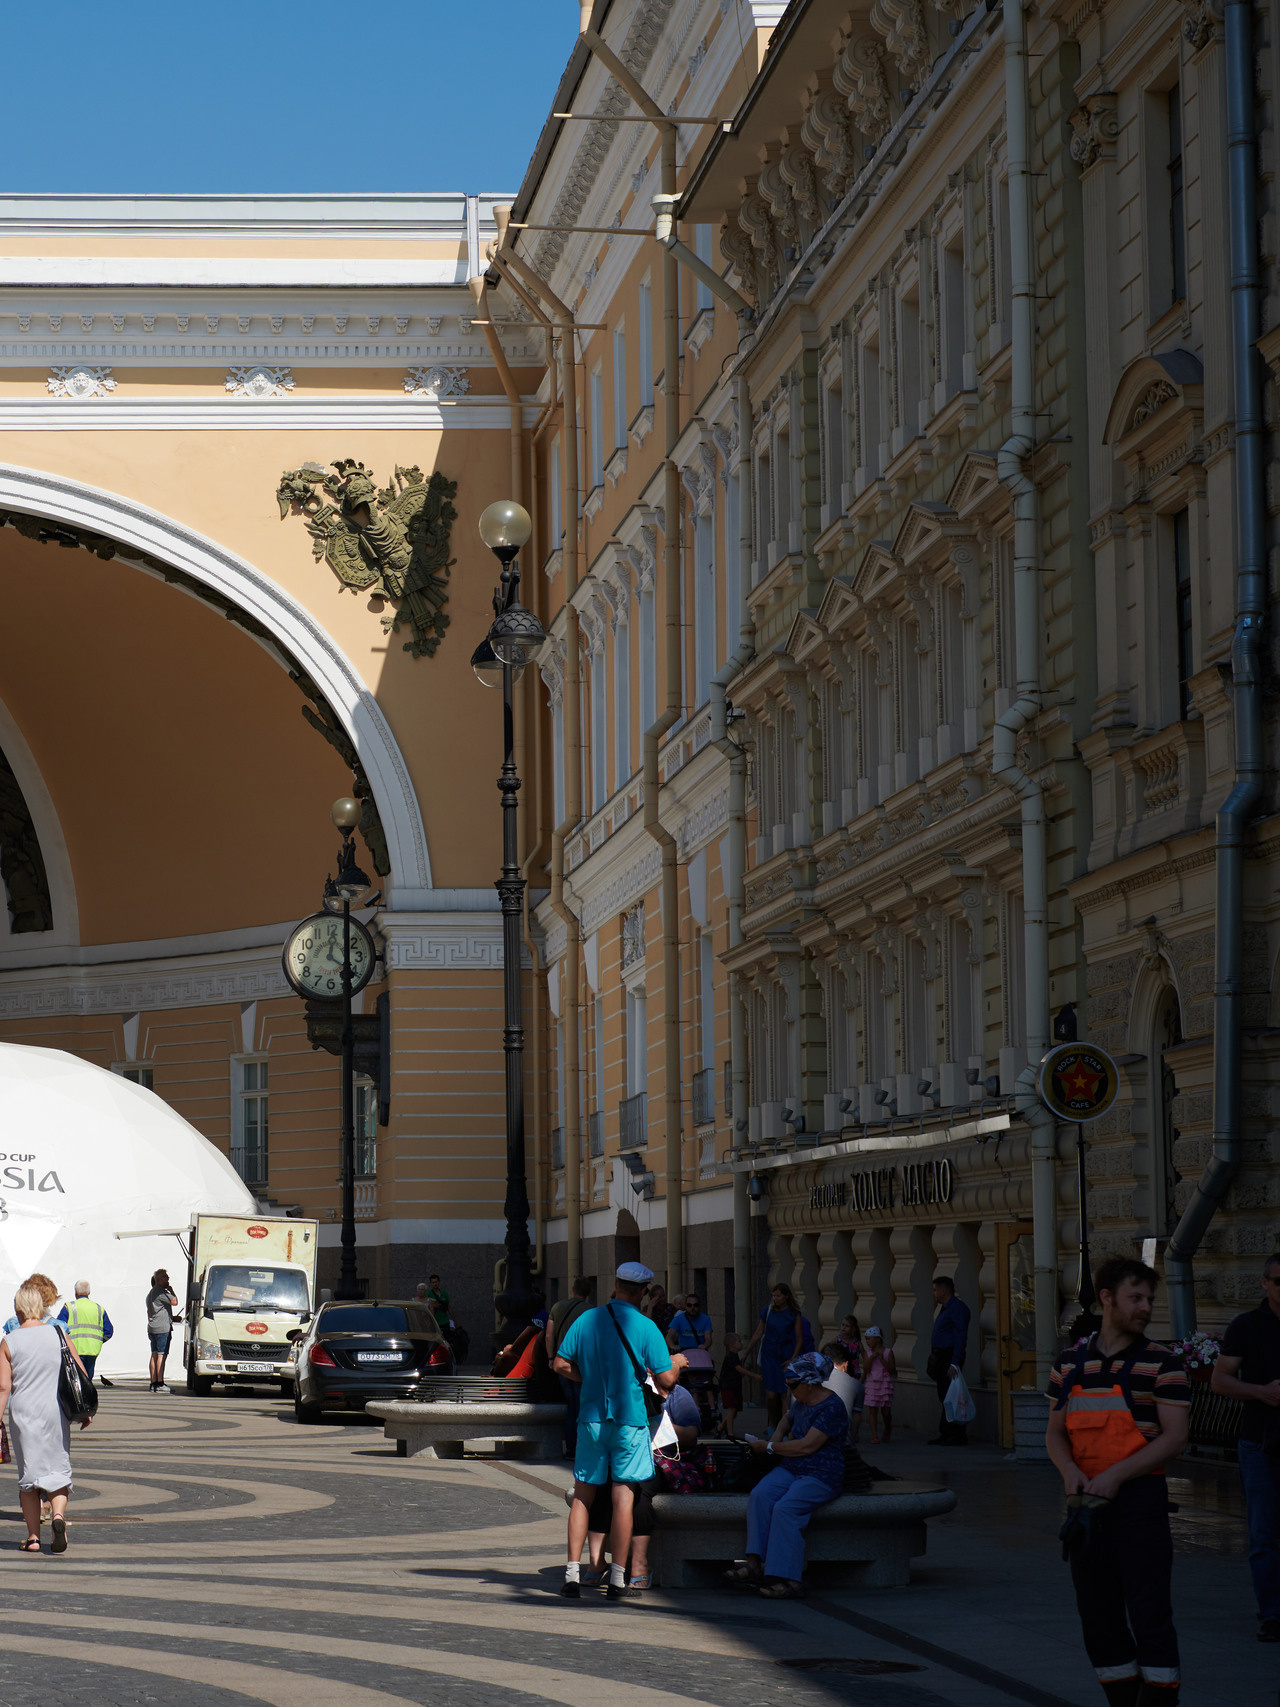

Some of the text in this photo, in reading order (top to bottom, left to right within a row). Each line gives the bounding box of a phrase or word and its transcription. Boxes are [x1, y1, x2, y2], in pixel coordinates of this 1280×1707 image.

[314, 928, 321, 939] 11
[327, 924, 338, 937] 12
[301, 938, 313, 950] 10
[350, 937, 359, 949] 2
[297, 953, 306, 964] 9
[355, 951, 363, 963] 3
[302, 966, 311, 978] 8
[314, 975, 323, 987] 7
[326, 979, 336, 990] 6
[1059, 1024, 1065, 1034] 4
[1057, 1055, 1102, 1072] ROCK STAR
[1070, 1101, 1090, 1109] CAFE
[9, 1153, 37, 1162] CUP
[809, 1158, 952, 1211] РЕСТОРАН ХОЛСТ МАСЛО
